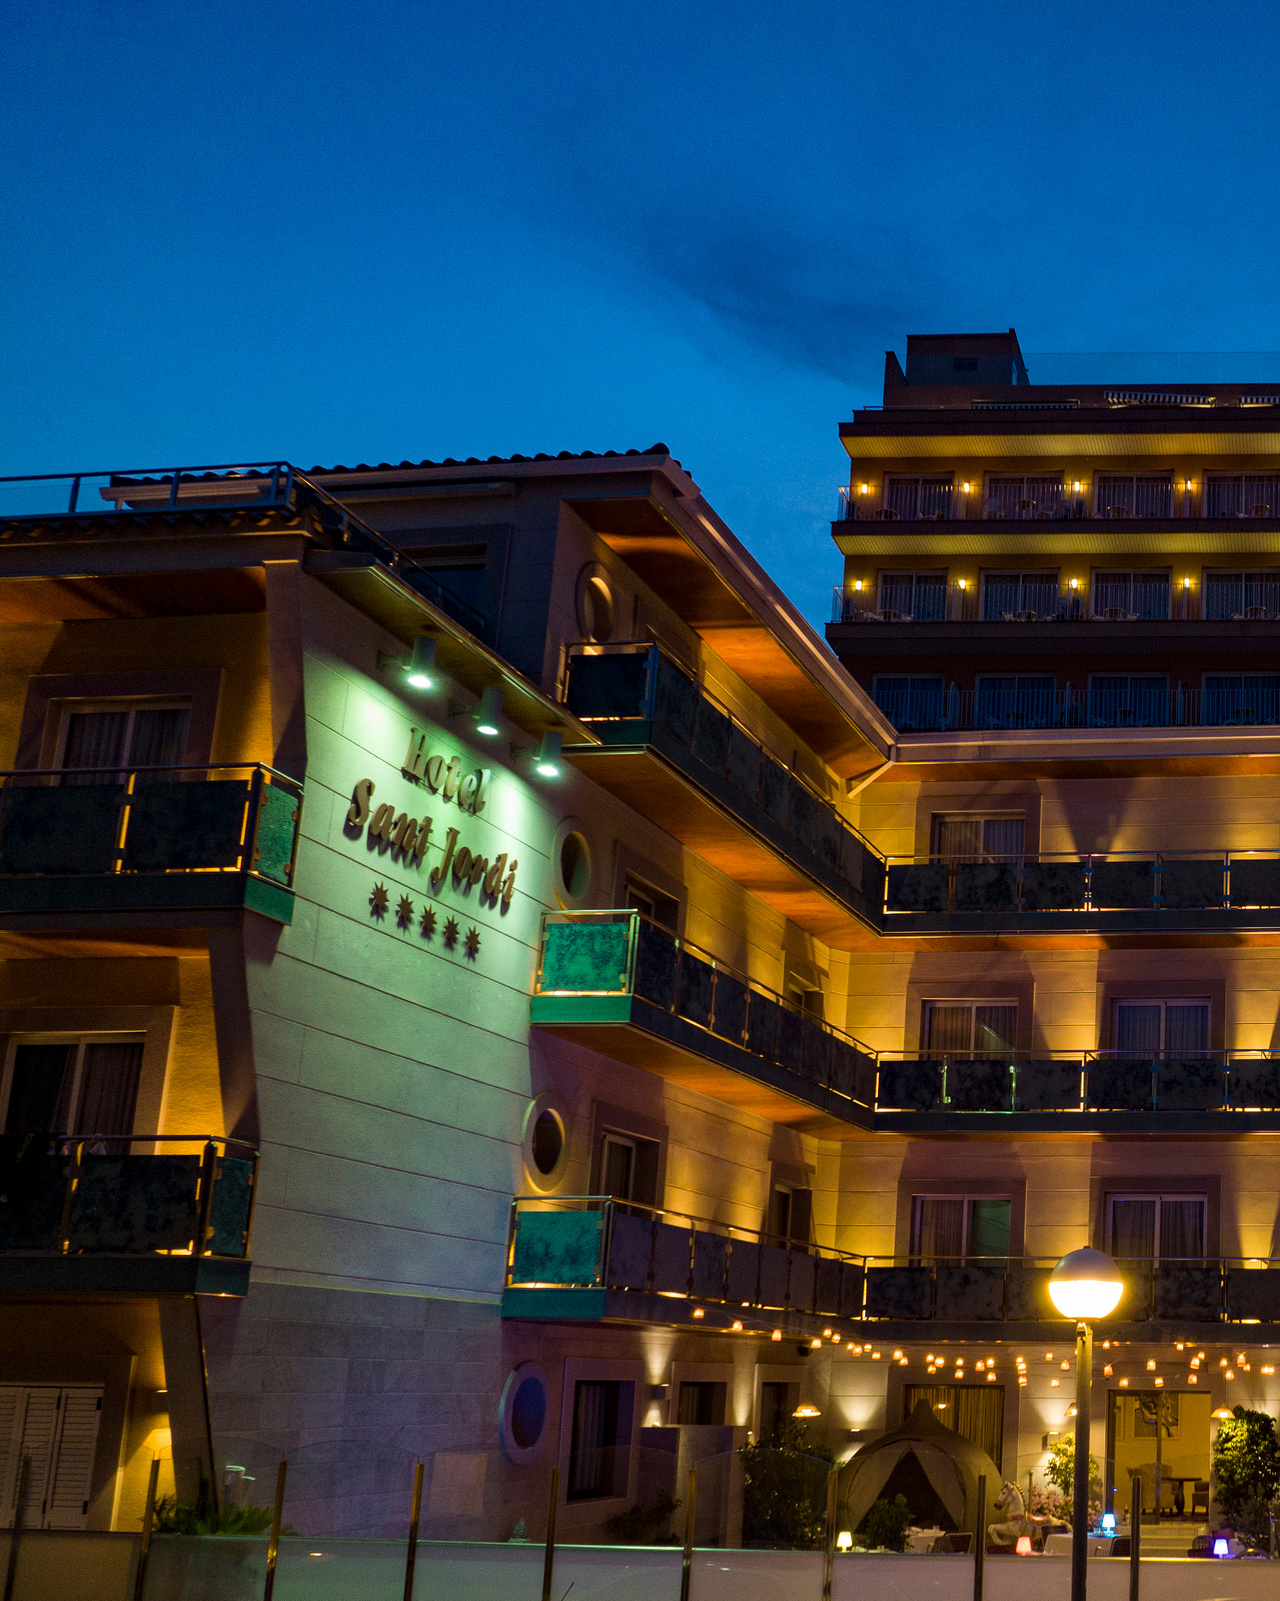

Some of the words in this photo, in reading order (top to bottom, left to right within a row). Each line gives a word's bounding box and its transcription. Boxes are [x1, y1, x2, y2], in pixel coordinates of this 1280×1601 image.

[402, 728, 491, 814] Hotel
[348, 778, 433, 858] Sant
[431, 827, 518, 902] Jordi
